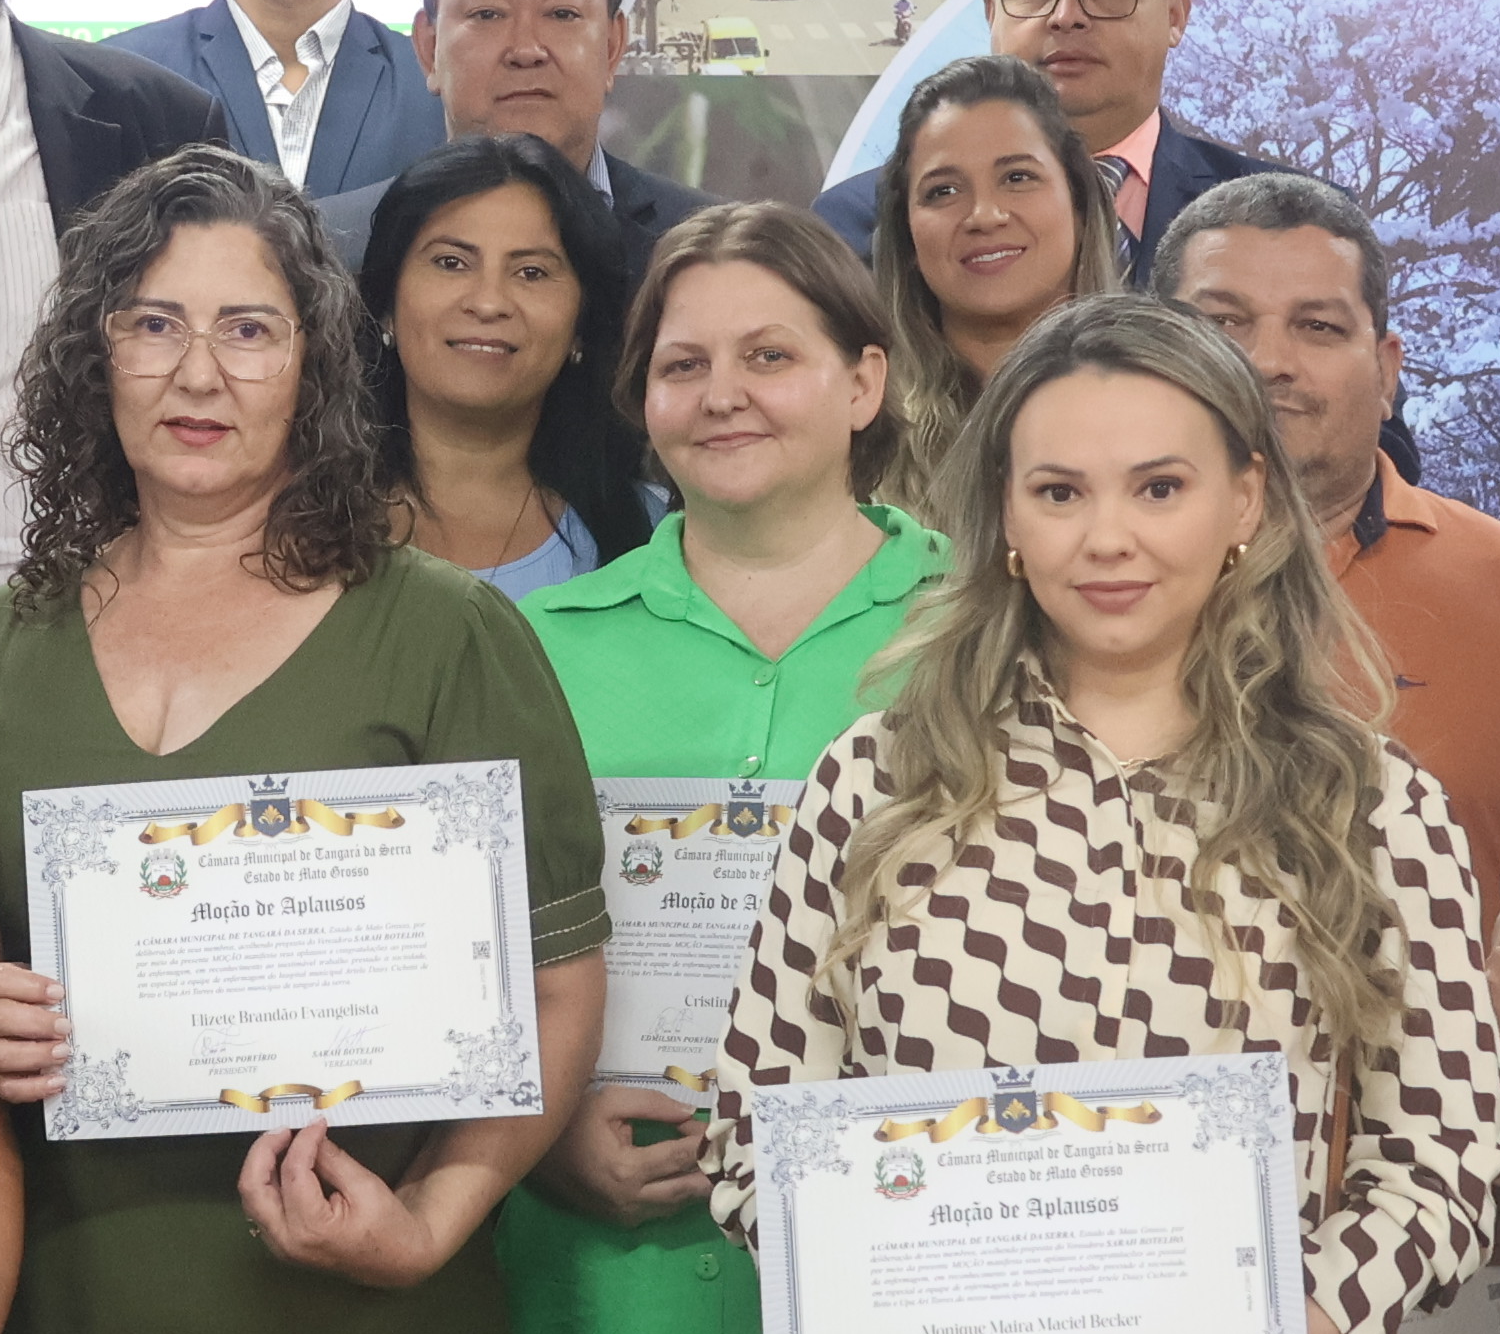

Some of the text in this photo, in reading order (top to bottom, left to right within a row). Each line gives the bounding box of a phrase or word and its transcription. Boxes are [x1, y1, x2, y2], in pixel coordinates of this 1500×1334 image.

[198, 844, 411, 868] Câmara Municipal de Tangará da Serra
[244, 866, 369, 884] Estado de Mato Grosso
[713, 868, 760, 880] Estado de
[191, 895, 365, 923] Moção de Aplausos
[660, 892, 738, 915] Moção de
[684, 994, 729, 1008] Cristin
[192, 1004, 378, 1027] Elizete Brandão Evangelista
[929, 1197, 1118, 1227] Moção de Aplausos
[990, 1320, 1033, 1334] Maira
[1038, 1315, 1086, 1331] Maciel
[1090, 1313, 1141, 1328] Becker
